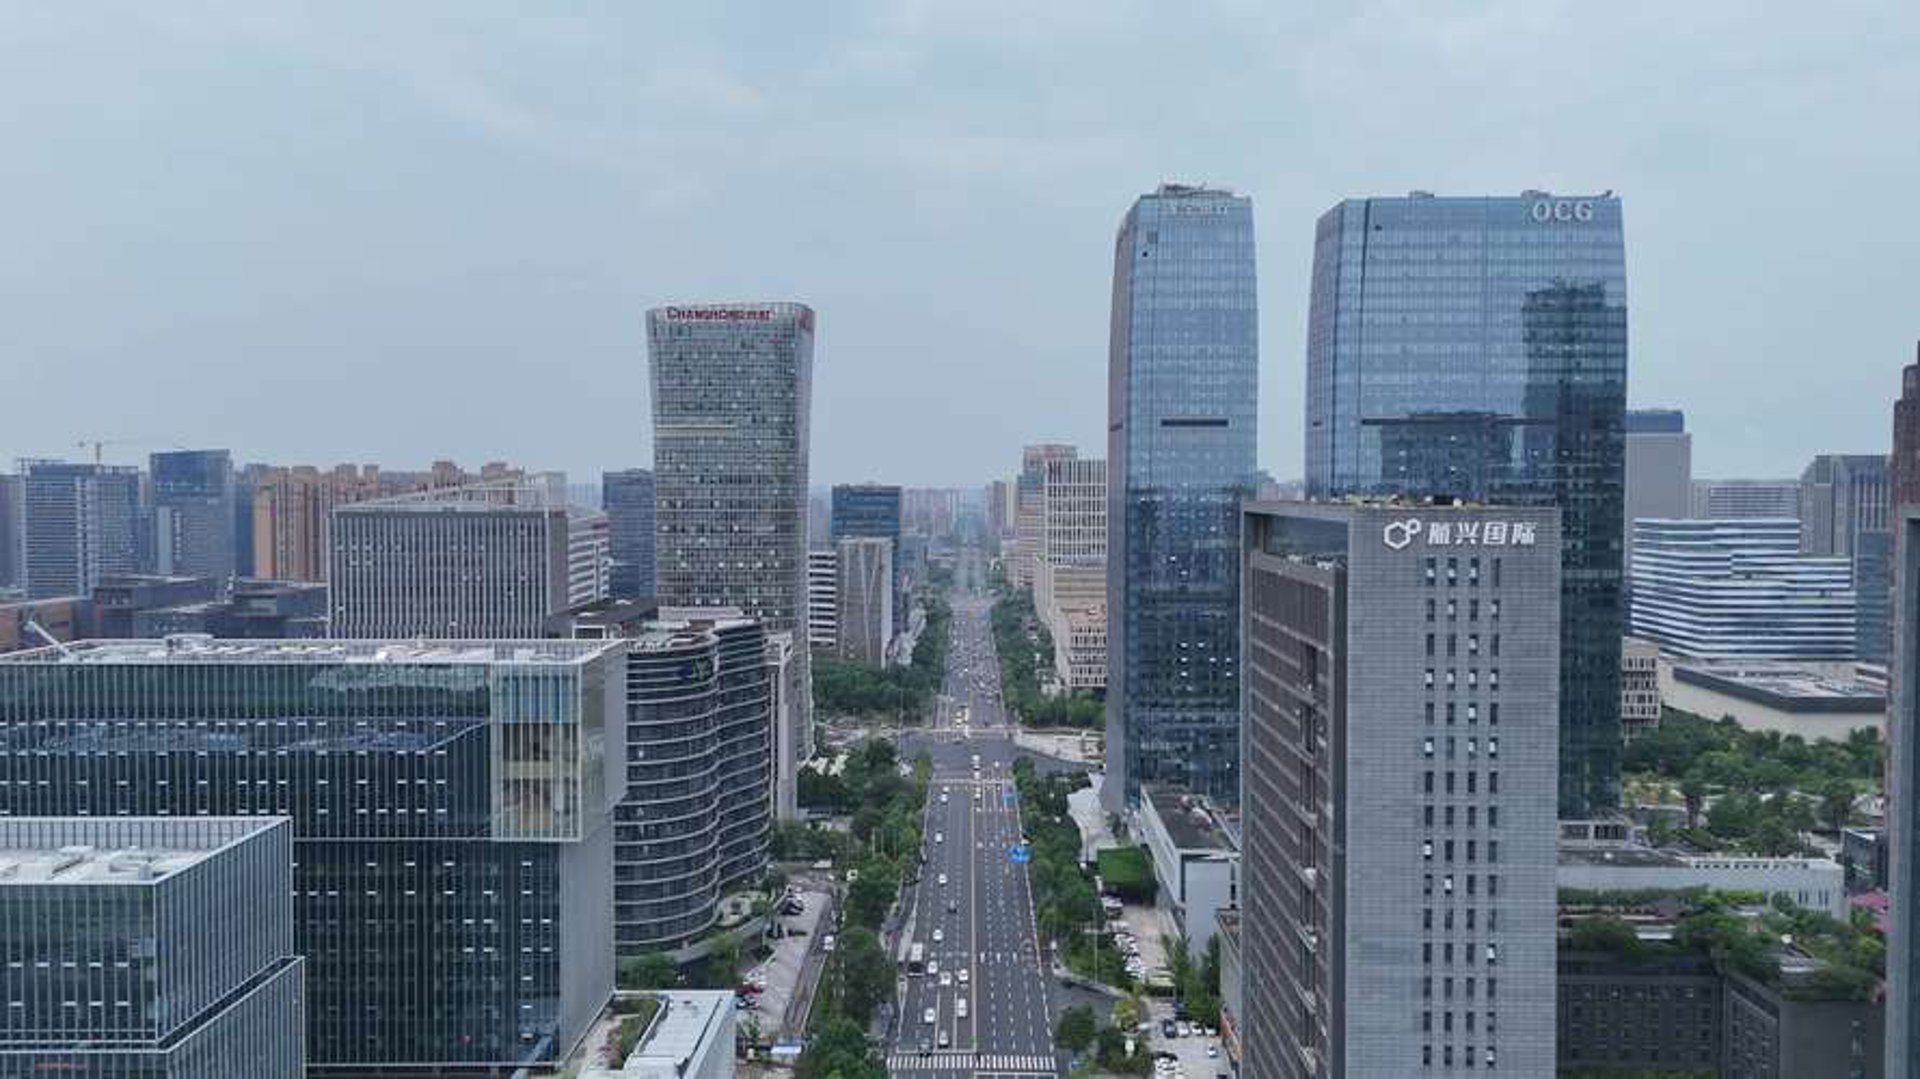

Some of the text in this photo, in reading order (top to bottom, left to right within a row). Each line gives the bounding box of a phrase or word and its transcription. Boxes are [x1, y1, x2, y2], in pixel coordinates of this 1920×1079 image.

[1532, 200, 1593, 221] OCG
[1428, 521, 1537, 545] 航兴国际
